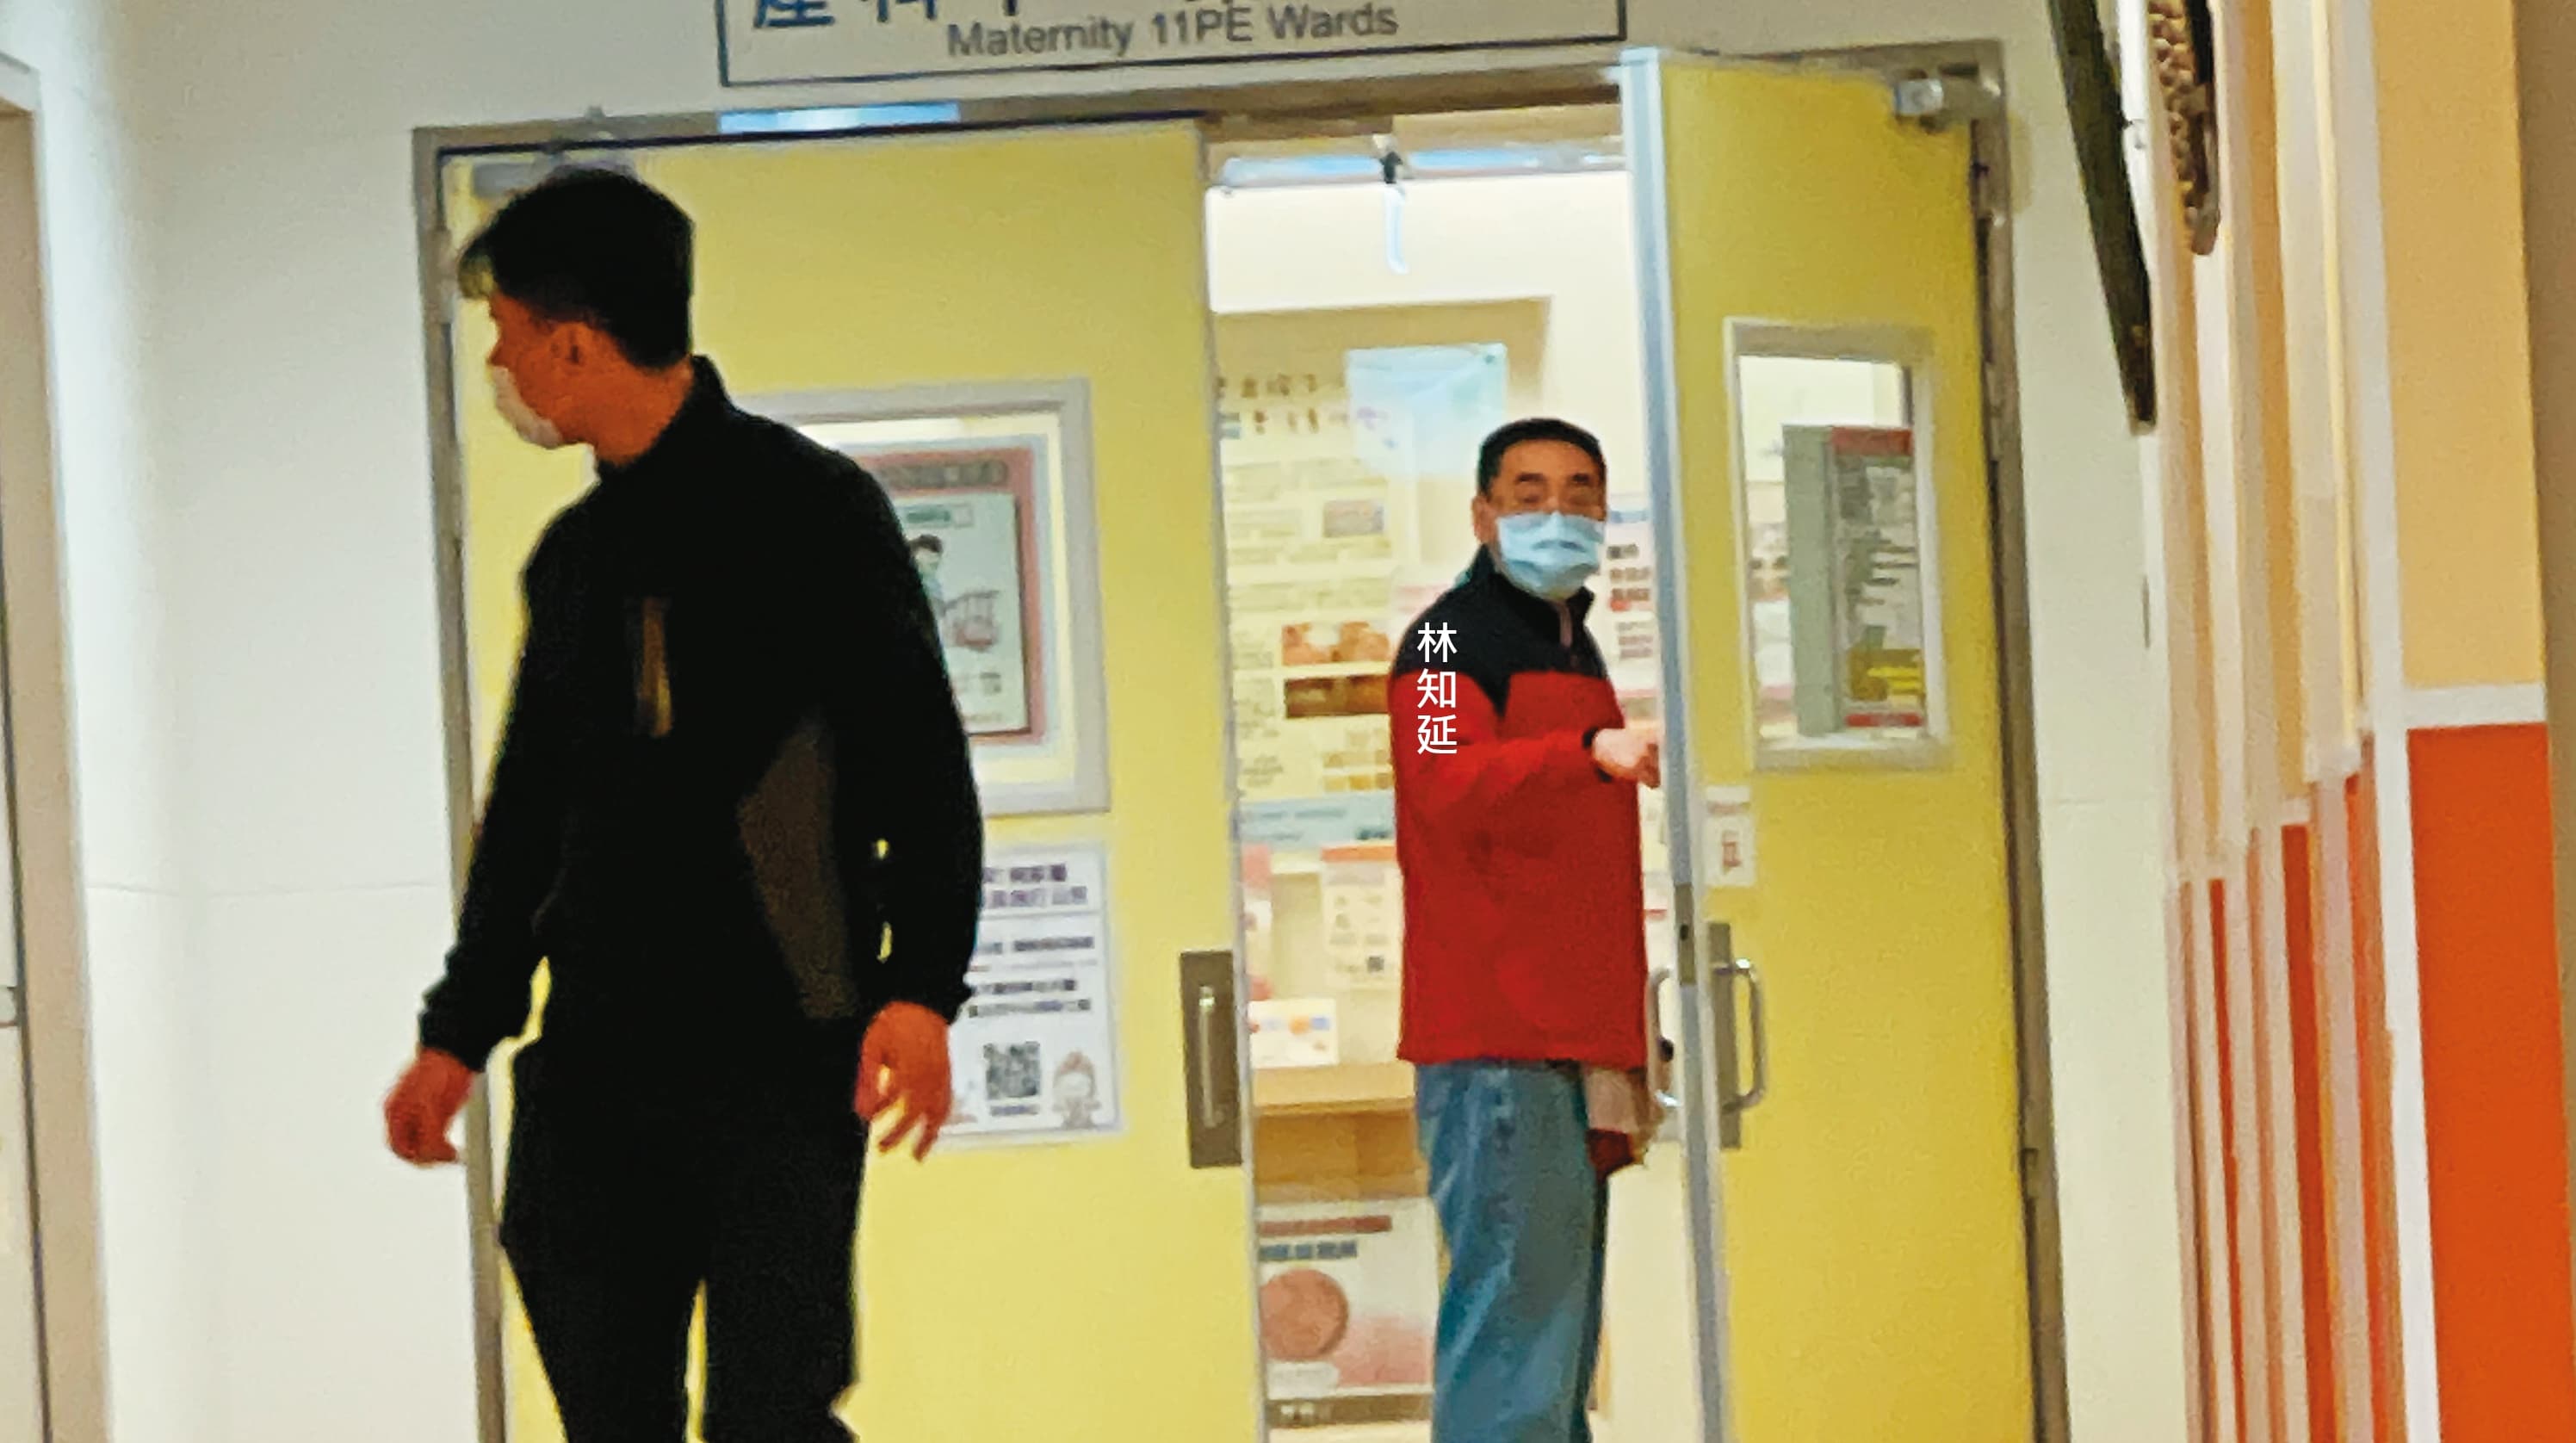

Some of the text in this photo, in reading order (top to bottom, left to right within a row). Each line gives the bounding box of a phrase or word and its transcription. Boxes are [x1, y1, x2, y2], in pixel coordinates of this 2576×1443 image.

[948, 3, 1399, 57] Maternity 11PE Wards
